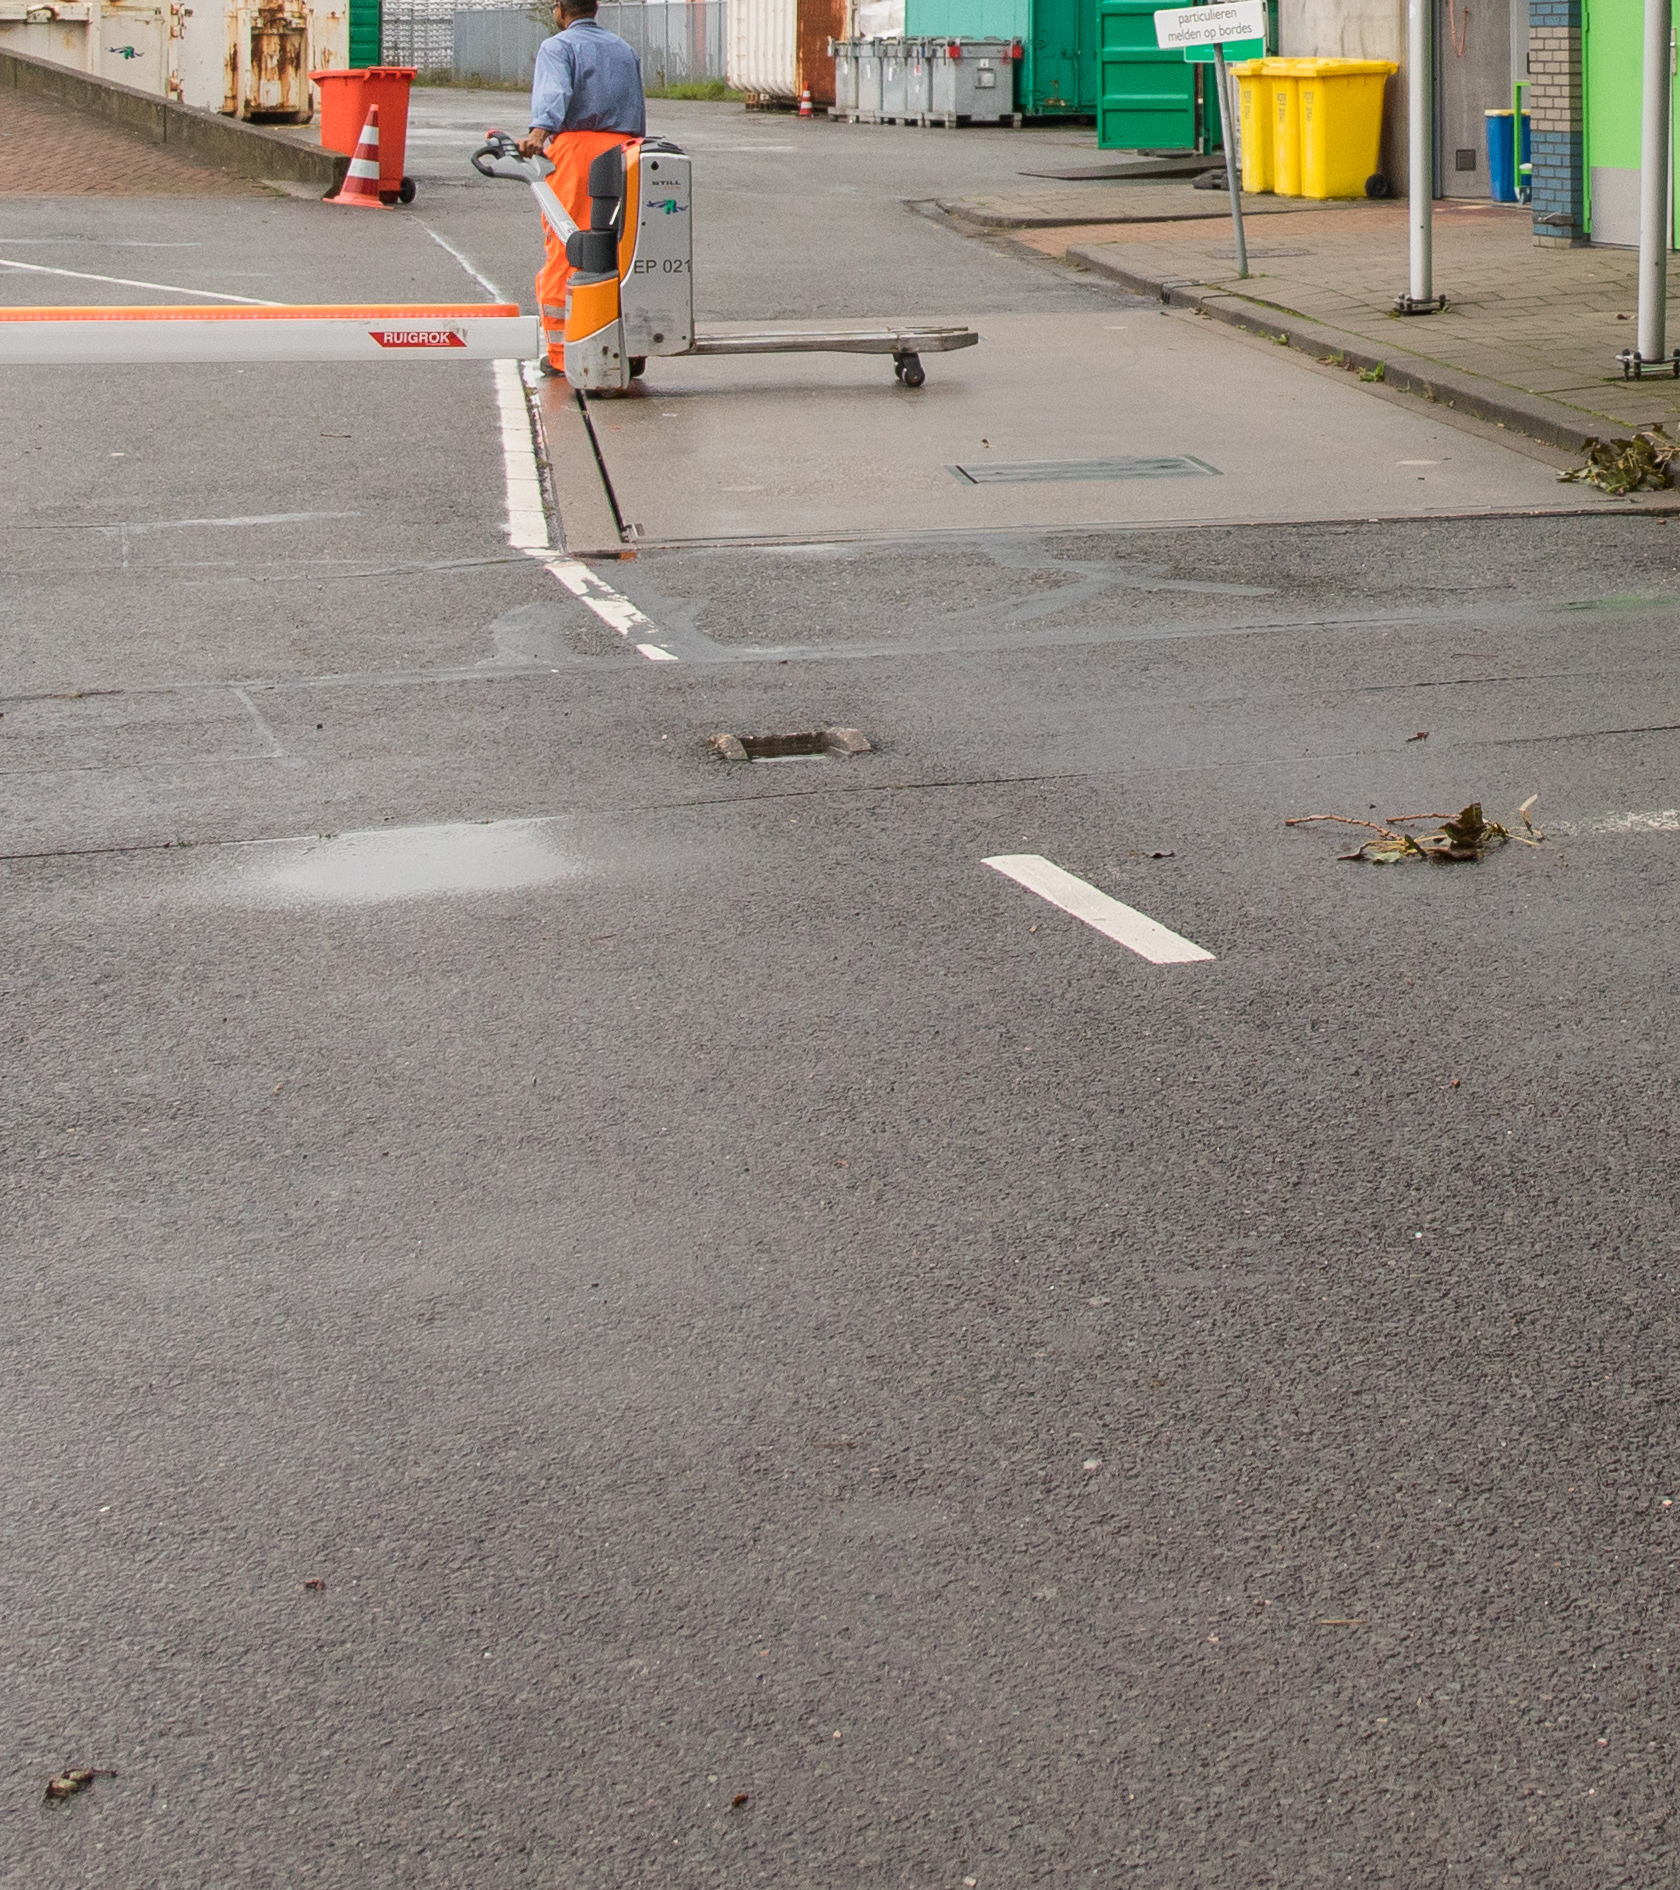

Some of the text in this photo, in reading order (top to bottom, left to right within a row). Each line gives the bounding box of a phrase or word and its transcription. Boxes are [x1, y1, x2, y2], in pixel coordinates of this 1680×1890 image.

[1178, 8, 1238, 27] particulieren
[1168, 23, 1253, 42] melden op bordes
[634, 259, 691, 274] EP 021
[383, 332, 450, 344] RUIGROK
